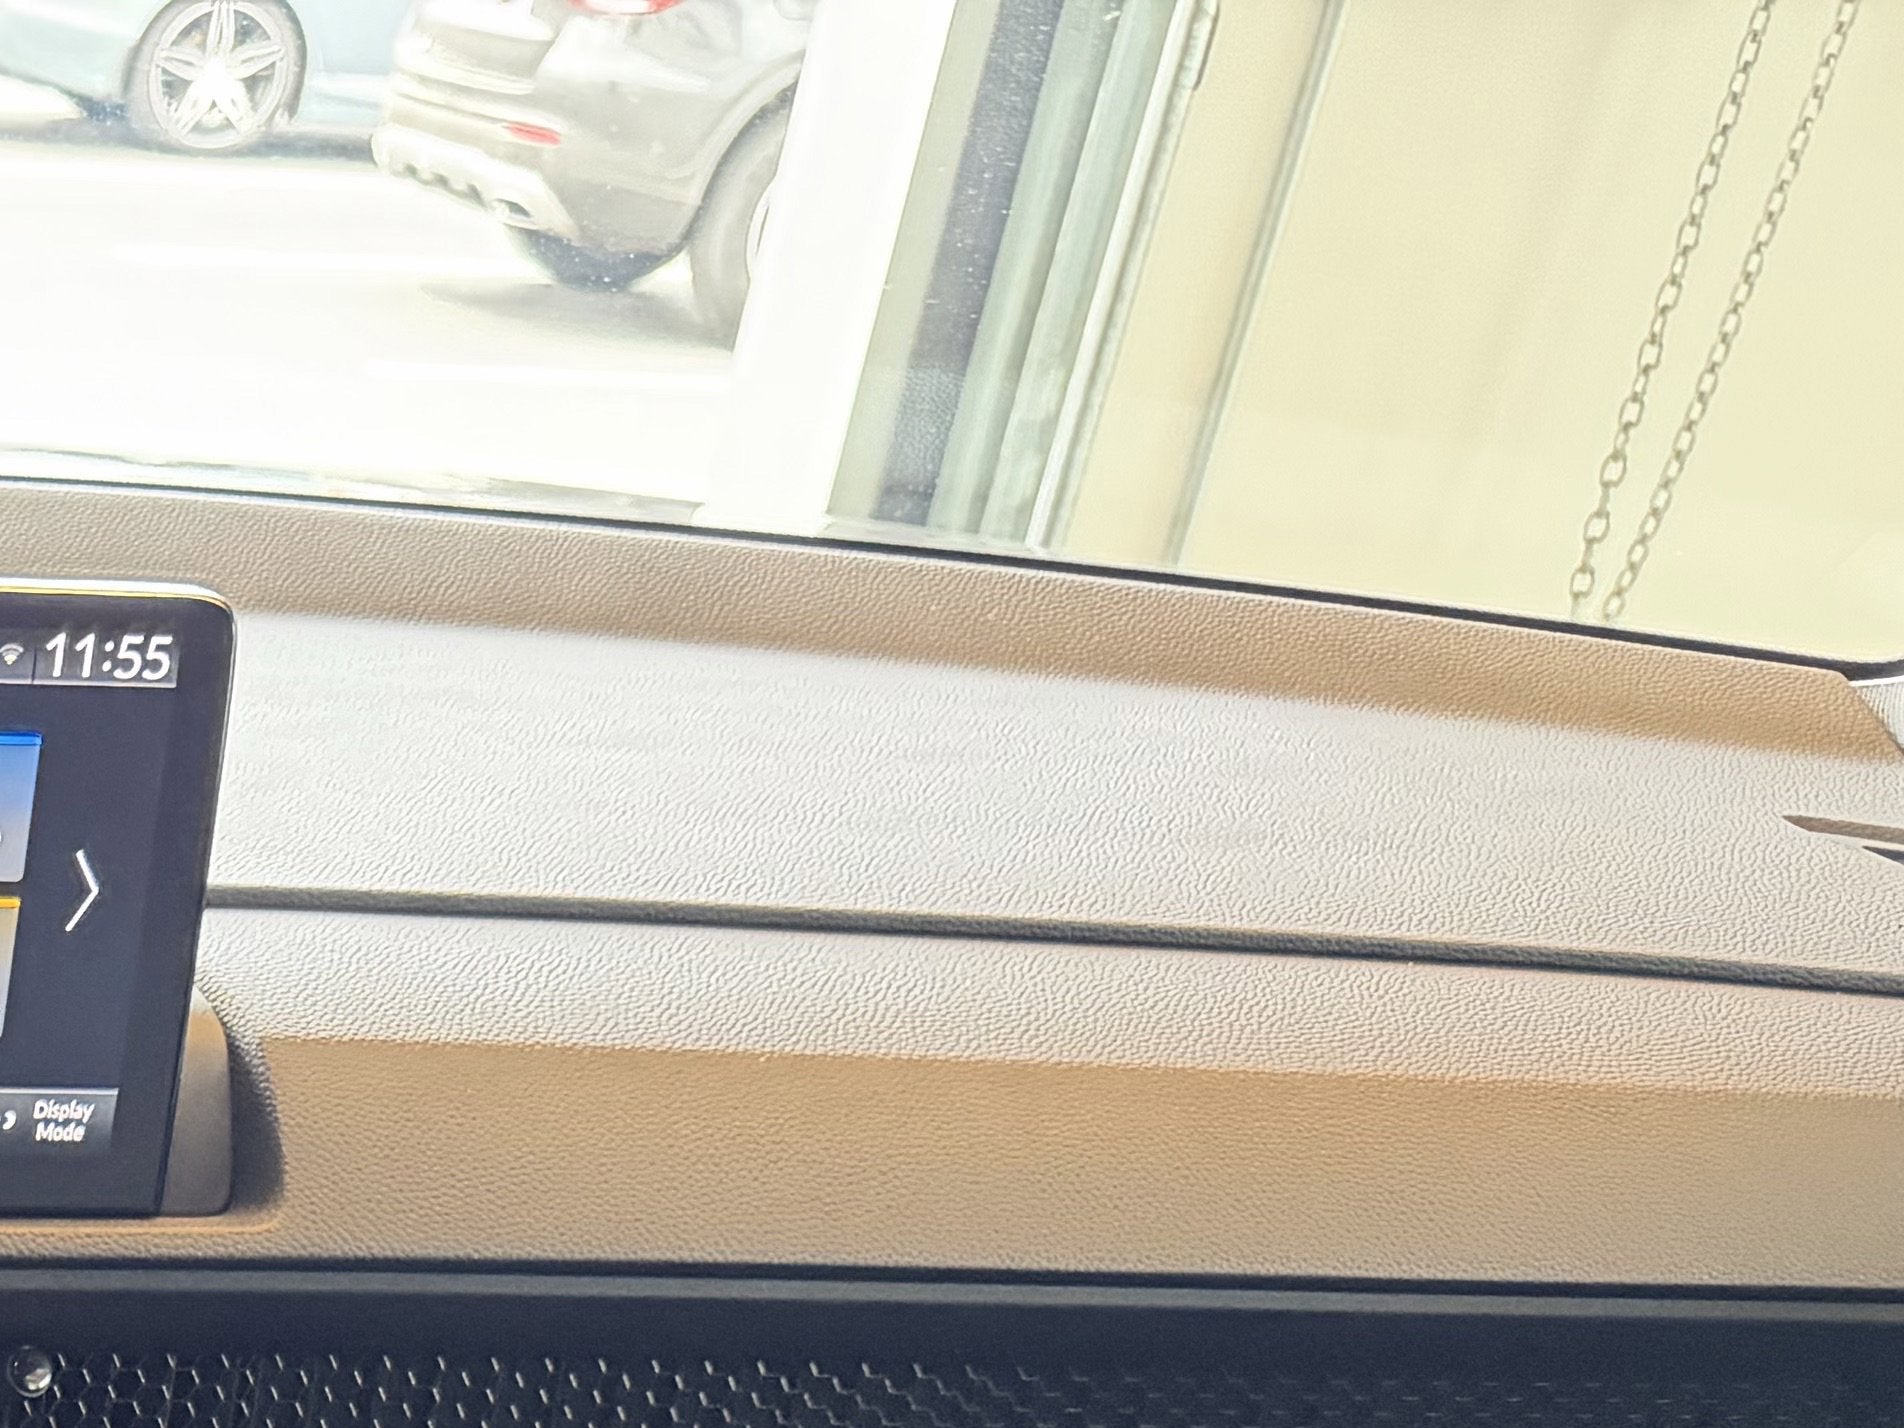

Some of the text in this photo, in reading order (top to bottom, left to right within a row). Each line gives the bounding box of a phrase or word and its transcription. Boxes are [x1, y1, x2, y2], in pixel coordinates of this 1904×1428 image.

[45, 632, 173, 680] 11:55
[32, 1099, 95, 1122] Display
[35, 1120, 85, 1142] Mode
